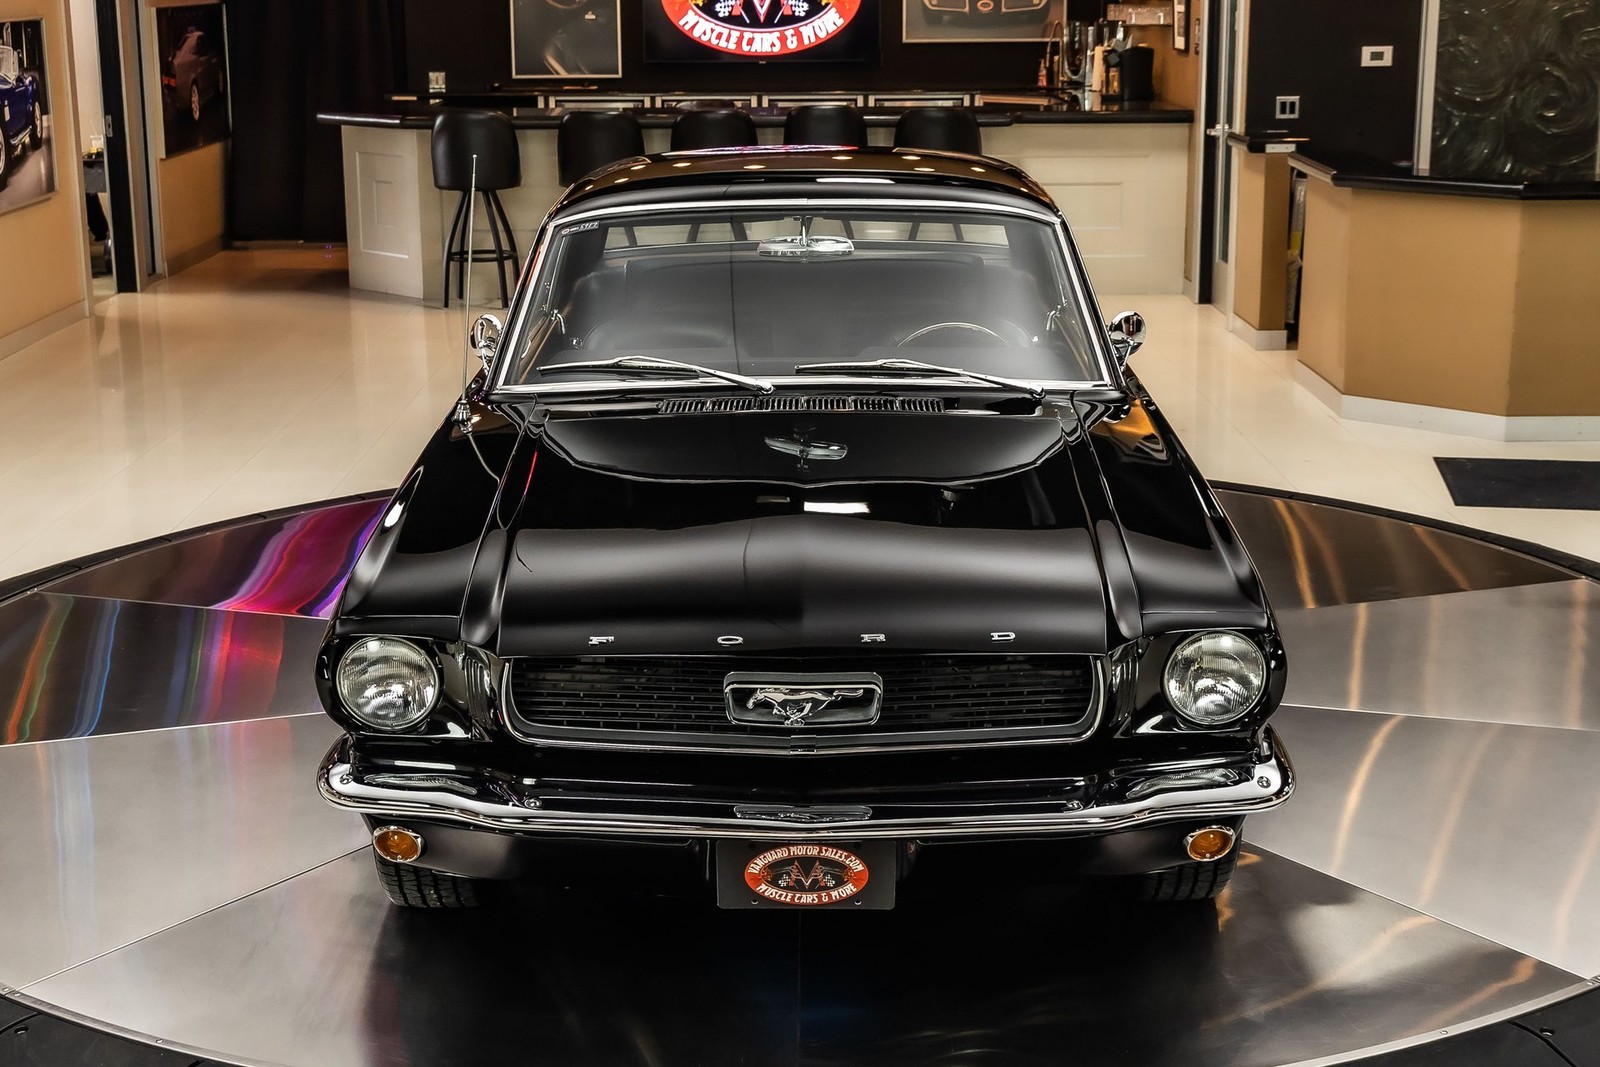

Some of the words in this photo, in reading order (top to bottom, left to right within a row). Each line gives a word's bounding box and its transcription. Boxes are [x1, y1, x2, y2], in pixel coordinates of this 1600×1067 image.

[678, 9, 740, 50] MUSCLE
[741, 31, 782, 53] CARS
[784, 28, 798, 50] &
[798, 7, 845, 46] MORE
[747, 847, 789, 875] VANGUARD
[789, 845, 820, 856] MOTOR
[820, 846, 865, 873] SALES.COM
[756, 882, 793, 903] MUSCLE
[794, 893, 818, 904] CARS
[821, 893, 829, 902] &
[830, 882, 858, 901] MORE
